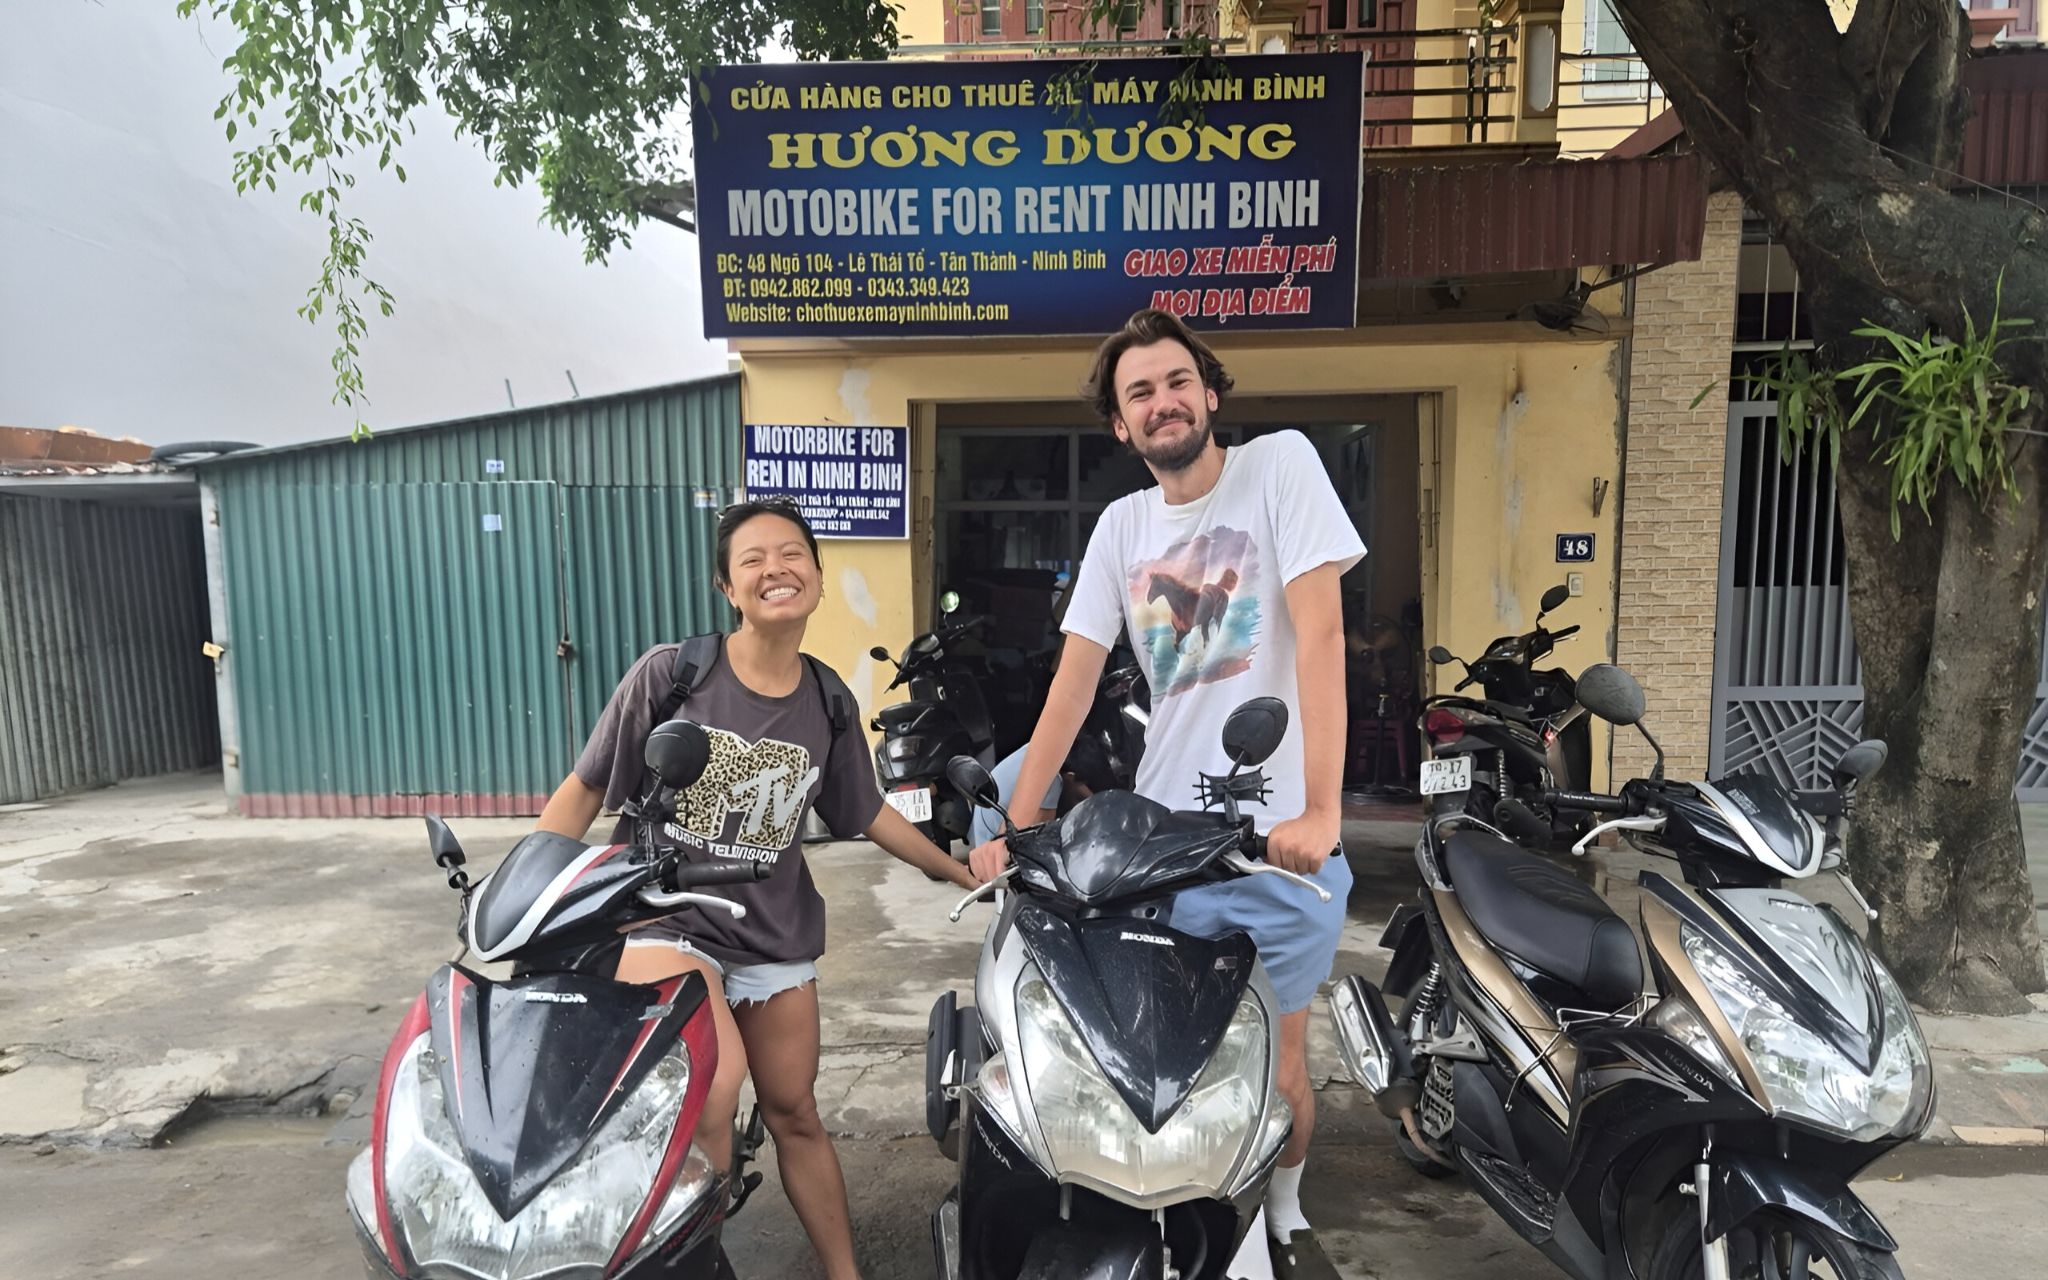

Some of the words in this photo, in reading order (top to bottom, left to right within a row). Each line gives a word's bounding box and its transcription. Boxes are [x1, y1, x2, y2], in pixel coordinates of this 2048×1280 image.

[730, 79, 791, 111] CỬA
[800, 82, 882, 110] HÀNG
[892, 84, 951, 108] CHO
[961, 79, 1035, 107] THUÊ
[1093, 76, 1159, 105] MÁY
[1253, 72, 1325, 101] BÌNH
[767, 124, 1021, 169] HƯƠNG
[1042, 119, 1296, 165] DƯƠNG
[727, 188, 920, 236] MOTOBIKE
[931, 187, 1002, 235] FOR
[1015, 184, 1111, 234] RENT
[1122, 182, 1216, 231] NINH
[1228, 179, 1320, 230] BINH
[716, 252, 743, 274] ĐC:
[747, 252, 766, 274] 48
[770, 252, 801, 276] Ngõ
[805, 252, 834, 273] 104
[870, 251, 903, 273] Thái
[940, 250, 967, 272] Tân
[971, 249, 1017, 271] Thành
[1032, 249, 1068, 271] Ninh
[1123, 248, 1188, 277] GIAO
[1188, 247, 1226, 276] XE
[1225, 233, 1292, 274] MIỄN
[1292, 235, 1338, 272] PHÍ
[723, 278, 747, 298] ĐT:
[750, 277, 853, 298] 0942.862.099
[867, 276, 970, 297] 0343.349.423
[1202, 287, 1246, 324] ĐỊA
[1249, 272, 1312, 315] ĐIỂM
[725, 301, 792, 323] Website:
[796, 300, 1009, 325] chothuexemayninhbinh.com
[754, 425, 857, 457] MOTORBIKE
[861, 428, 895, 458] FOR
[746, 459, 783, 488] REN
[787, 460, 807, 489] IN
[811, 461, 856, 490] NINH
[860, 463, 903, 492] BINH
[1563, 539, 1589, 556] 48
[1120, 931, 1175, 946] HONDA
[525, 991, 588, 1003] HONDA
